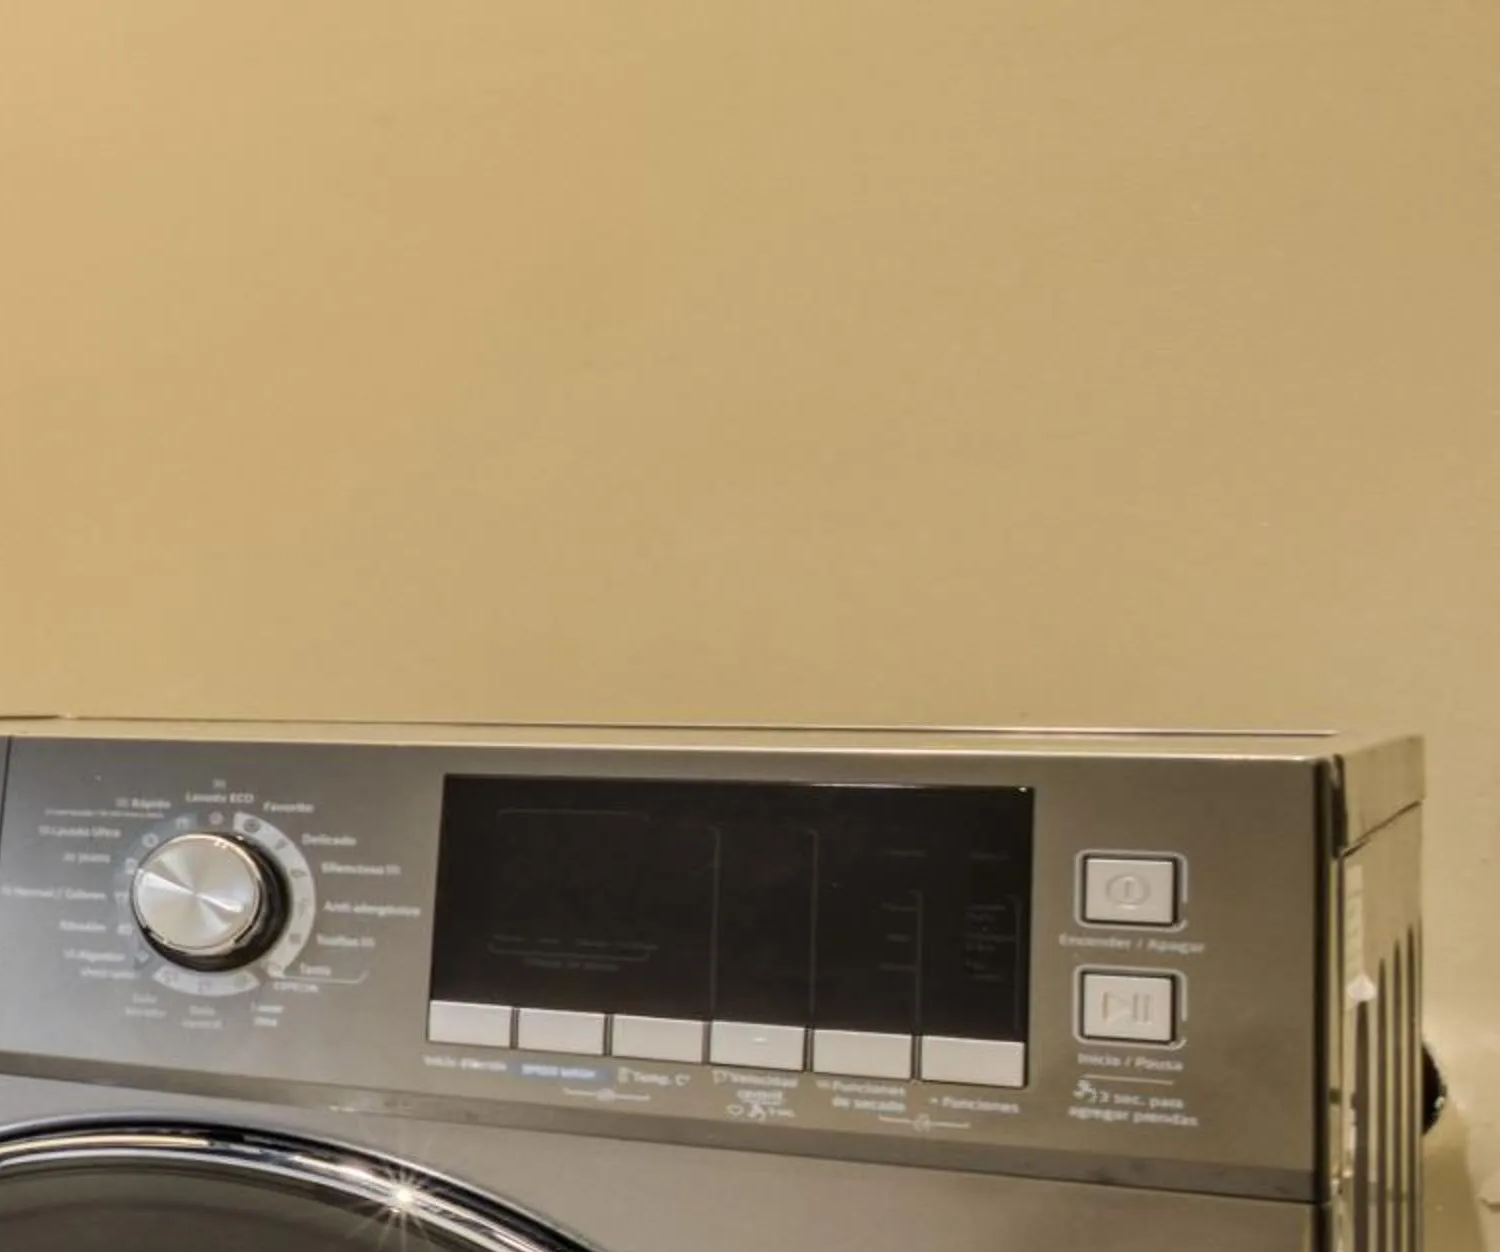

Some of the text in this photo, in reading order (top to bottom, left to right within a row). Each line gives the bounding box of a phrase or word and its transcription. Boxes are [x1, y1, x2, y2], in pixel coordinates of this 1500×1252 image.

[229, 792, 255, 804] ECO
[301, 833, 357, 846] Delicado
[1059, 932, 1132, 951] Encender
[1077, 1052, 1122, 1067] Inicio
[1134, 1056, 1184, 1071] Pausa
[833, 1080, 907, 1096] Funciones
[853, 1098, 907, 1112] secado
[942, 1096, 1020, 1114] Funciones
[1149, 1097, 1184, 1110] para
[1068, 1106, 1130, 1122] agregar
